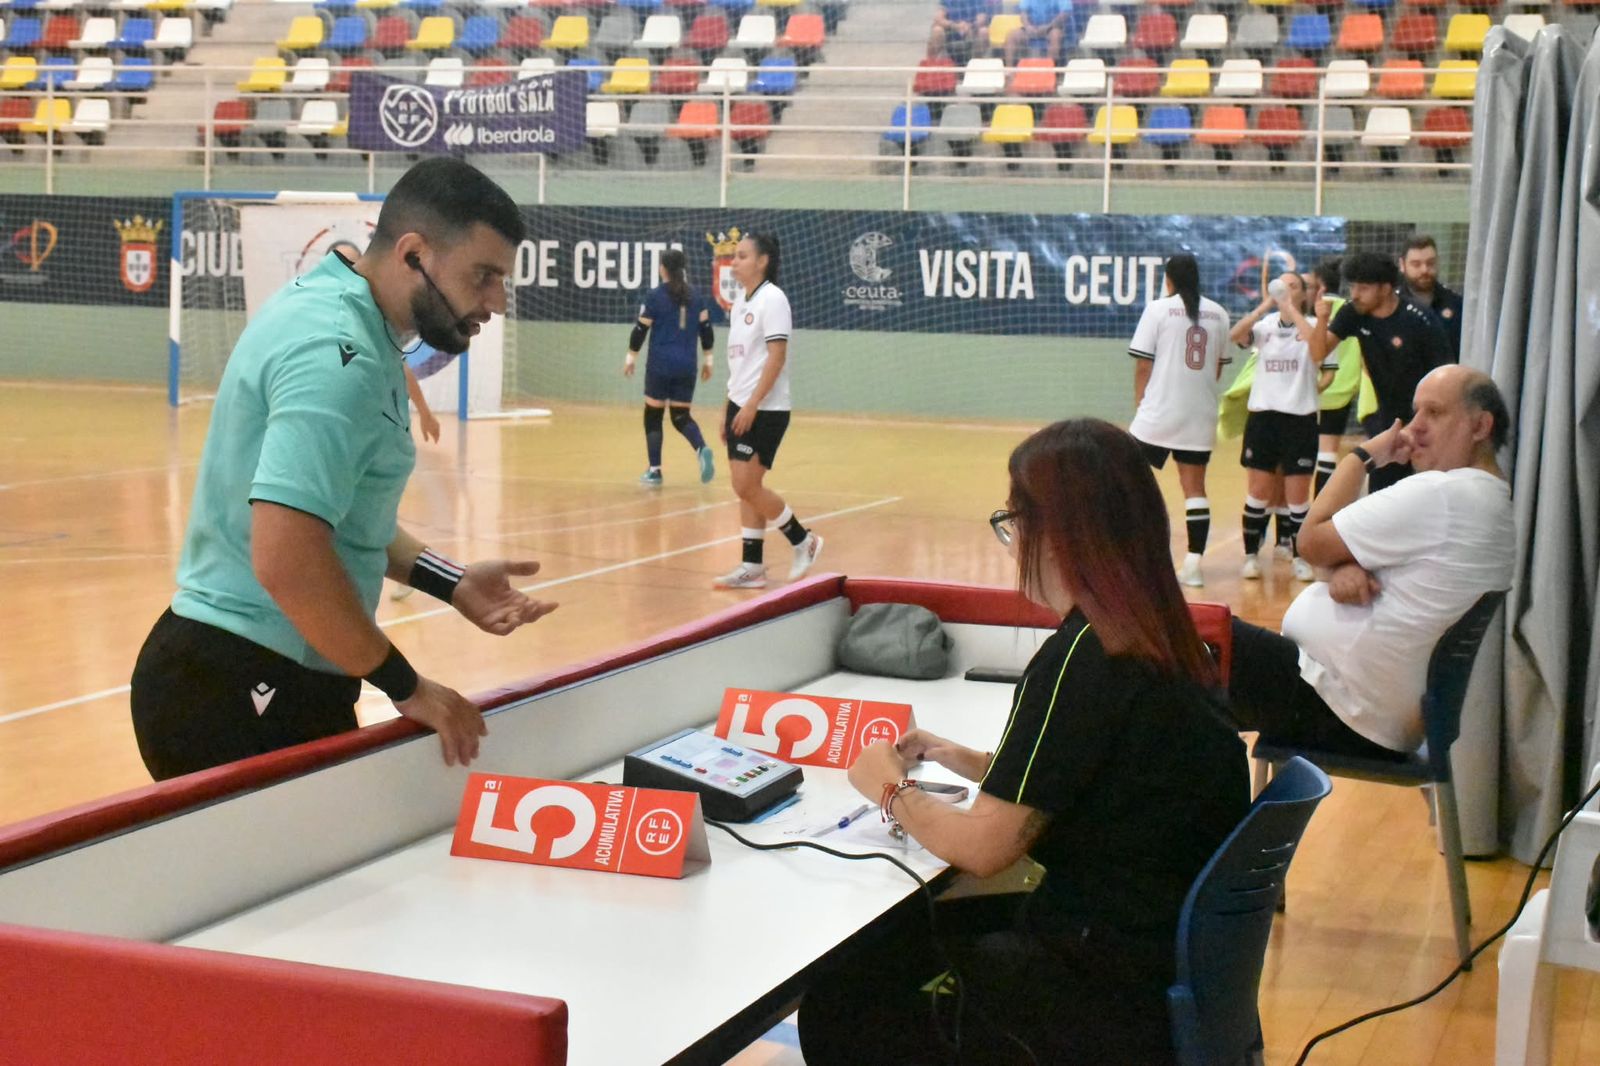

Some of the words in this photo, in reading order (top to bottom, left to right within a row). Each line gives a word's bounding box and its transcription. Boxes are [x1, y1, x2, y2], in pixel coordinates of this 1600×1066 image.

[519, 90, 555, 113] SALA
[477, 126, 555, 144] Iberdrola
[515, 240, 559, 287] DE
[574, 241, 688, 289] CEUT
[919, 249, 1035, 300] VISITA
[846, 285, 898, 299] ceuta
[1185, 325, 1208, 371] 8
[1265, 359, 1299, 373] CEUTA
[826, 702, 853, 764] ACUMULATIVA
[594, 789, 626, 866] ACUMULATIVA
